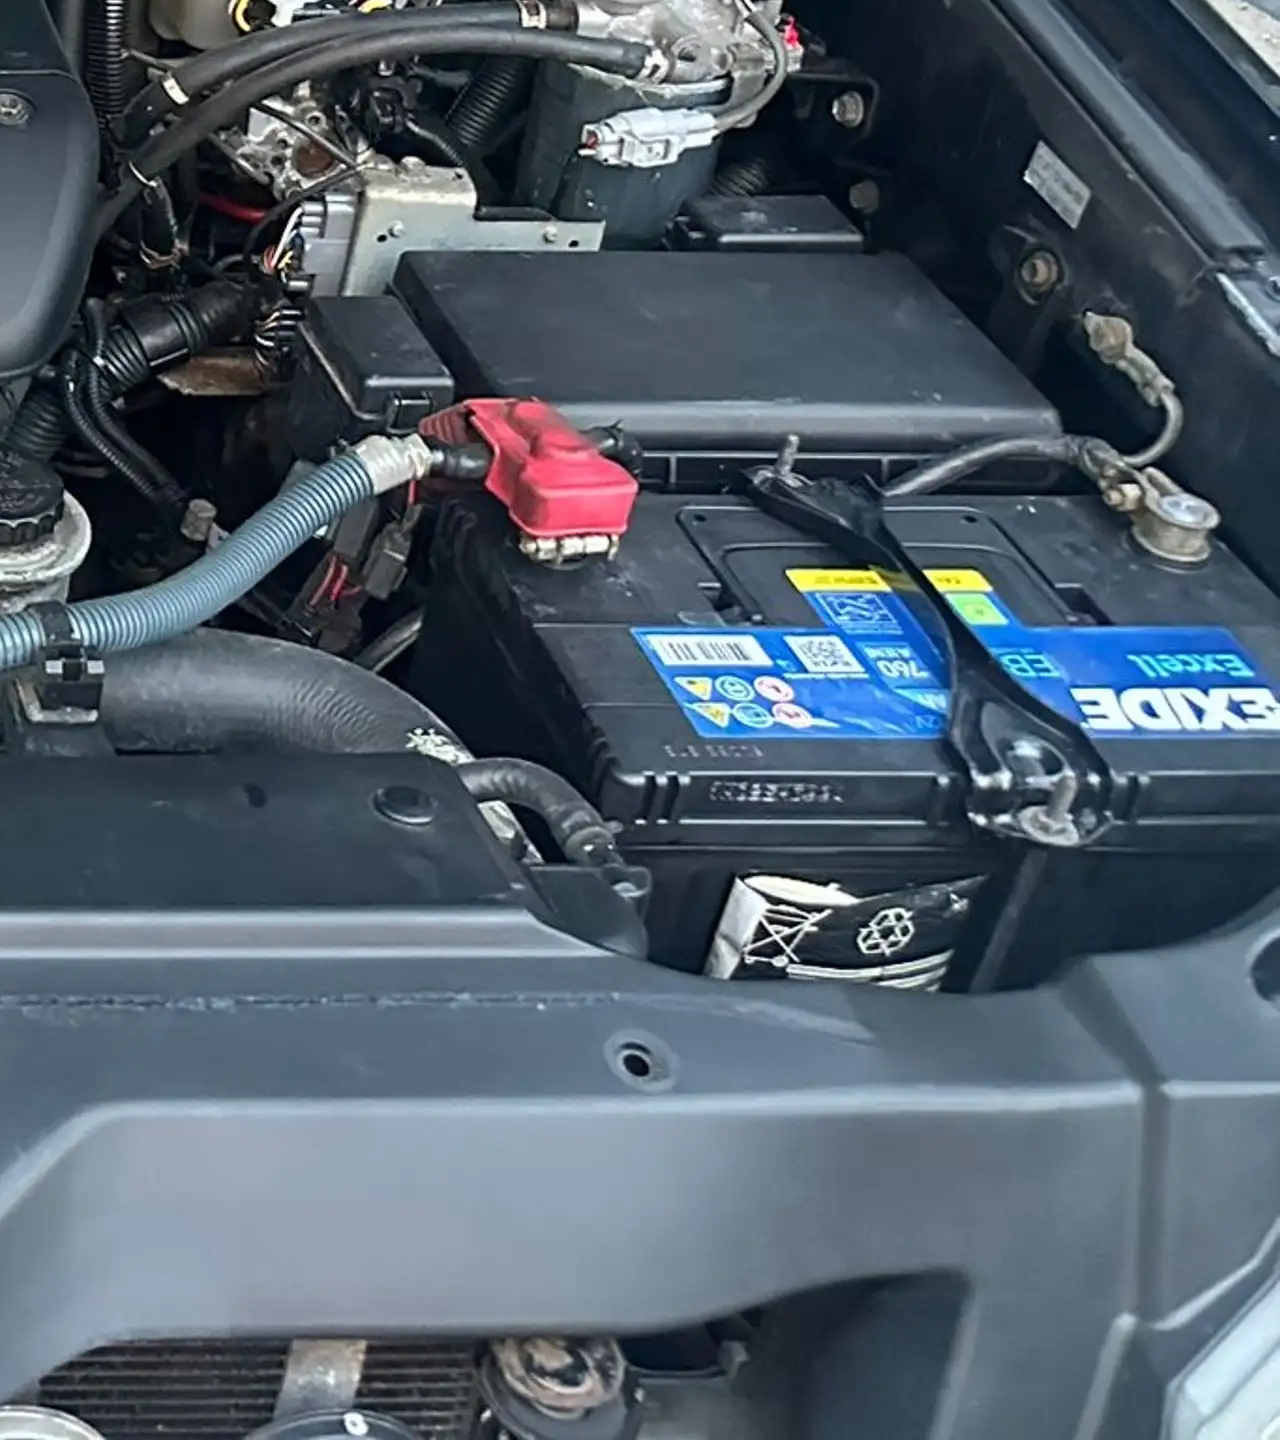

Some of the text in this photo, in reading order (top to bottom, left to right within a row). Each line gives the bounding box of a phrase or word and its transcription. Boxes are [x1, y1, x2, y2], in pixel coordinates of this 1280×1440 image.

[881, 660, 930, 679] 760
[1126, 654, 1256, 678] Excell
[1069, 687, 1280, 732] EXIDE
